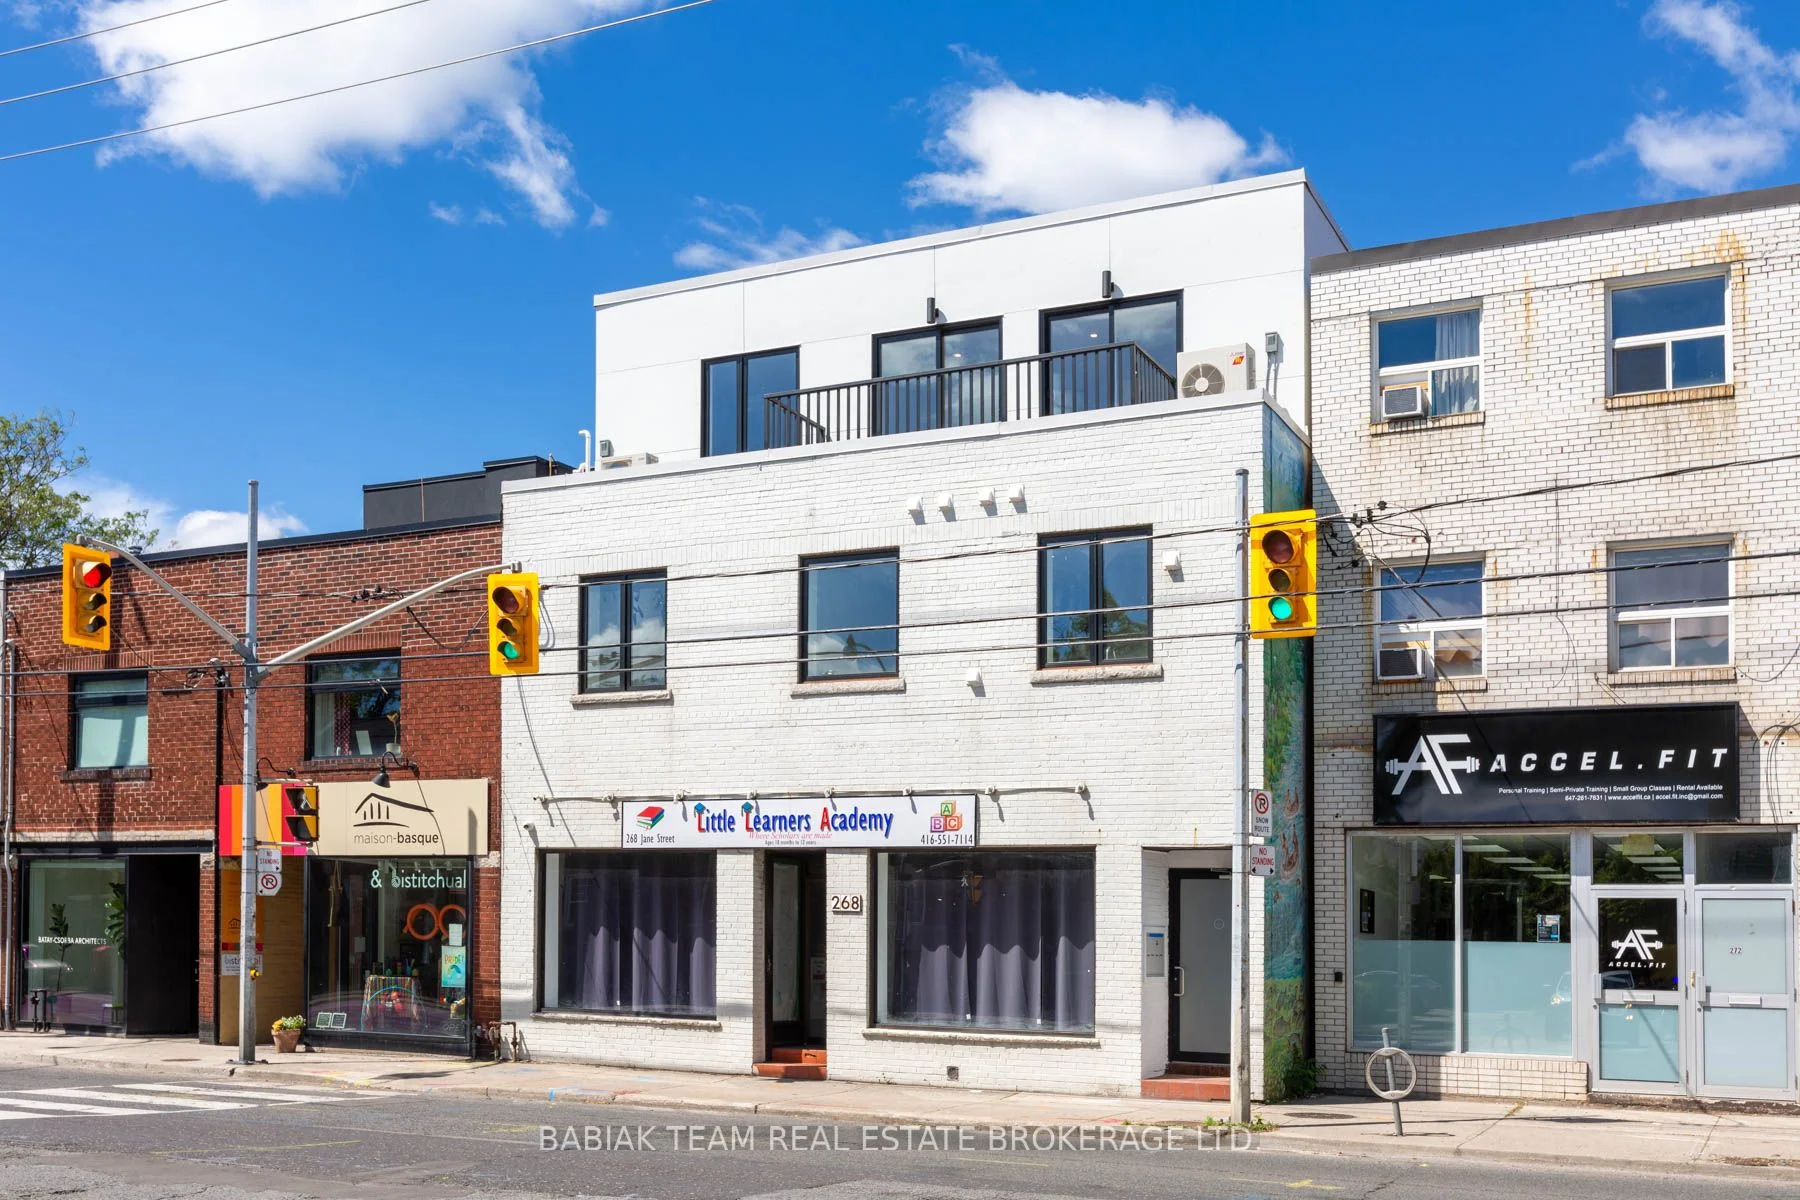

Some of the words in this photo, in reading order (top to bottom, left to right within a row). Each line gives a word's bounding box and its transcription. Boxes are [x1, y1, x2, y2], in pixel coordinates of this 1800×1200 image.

[1490, 748, 1728, 773] ACCEL.FIT
[696, 808, 735, 832] Little
[745, 808, 811, 832] Learners
[820, 806, 894, 839] Academy
[354, 832, 439, 845] maison-basque
[626, 834, 638, 844] 268
[640, 834, 654, 845] Jane
[657, 833, 675, 844] Street
[920, 834, 973, 845] 416-551-7114
[1252, 857, 1274, 866] STANDING
[370, 869, 382, 888] &
[391, 867, 467, 888] bistitchual
[831, 895, 860, 910] 268
[75, 937, 107, 945] ARCHITECTS
